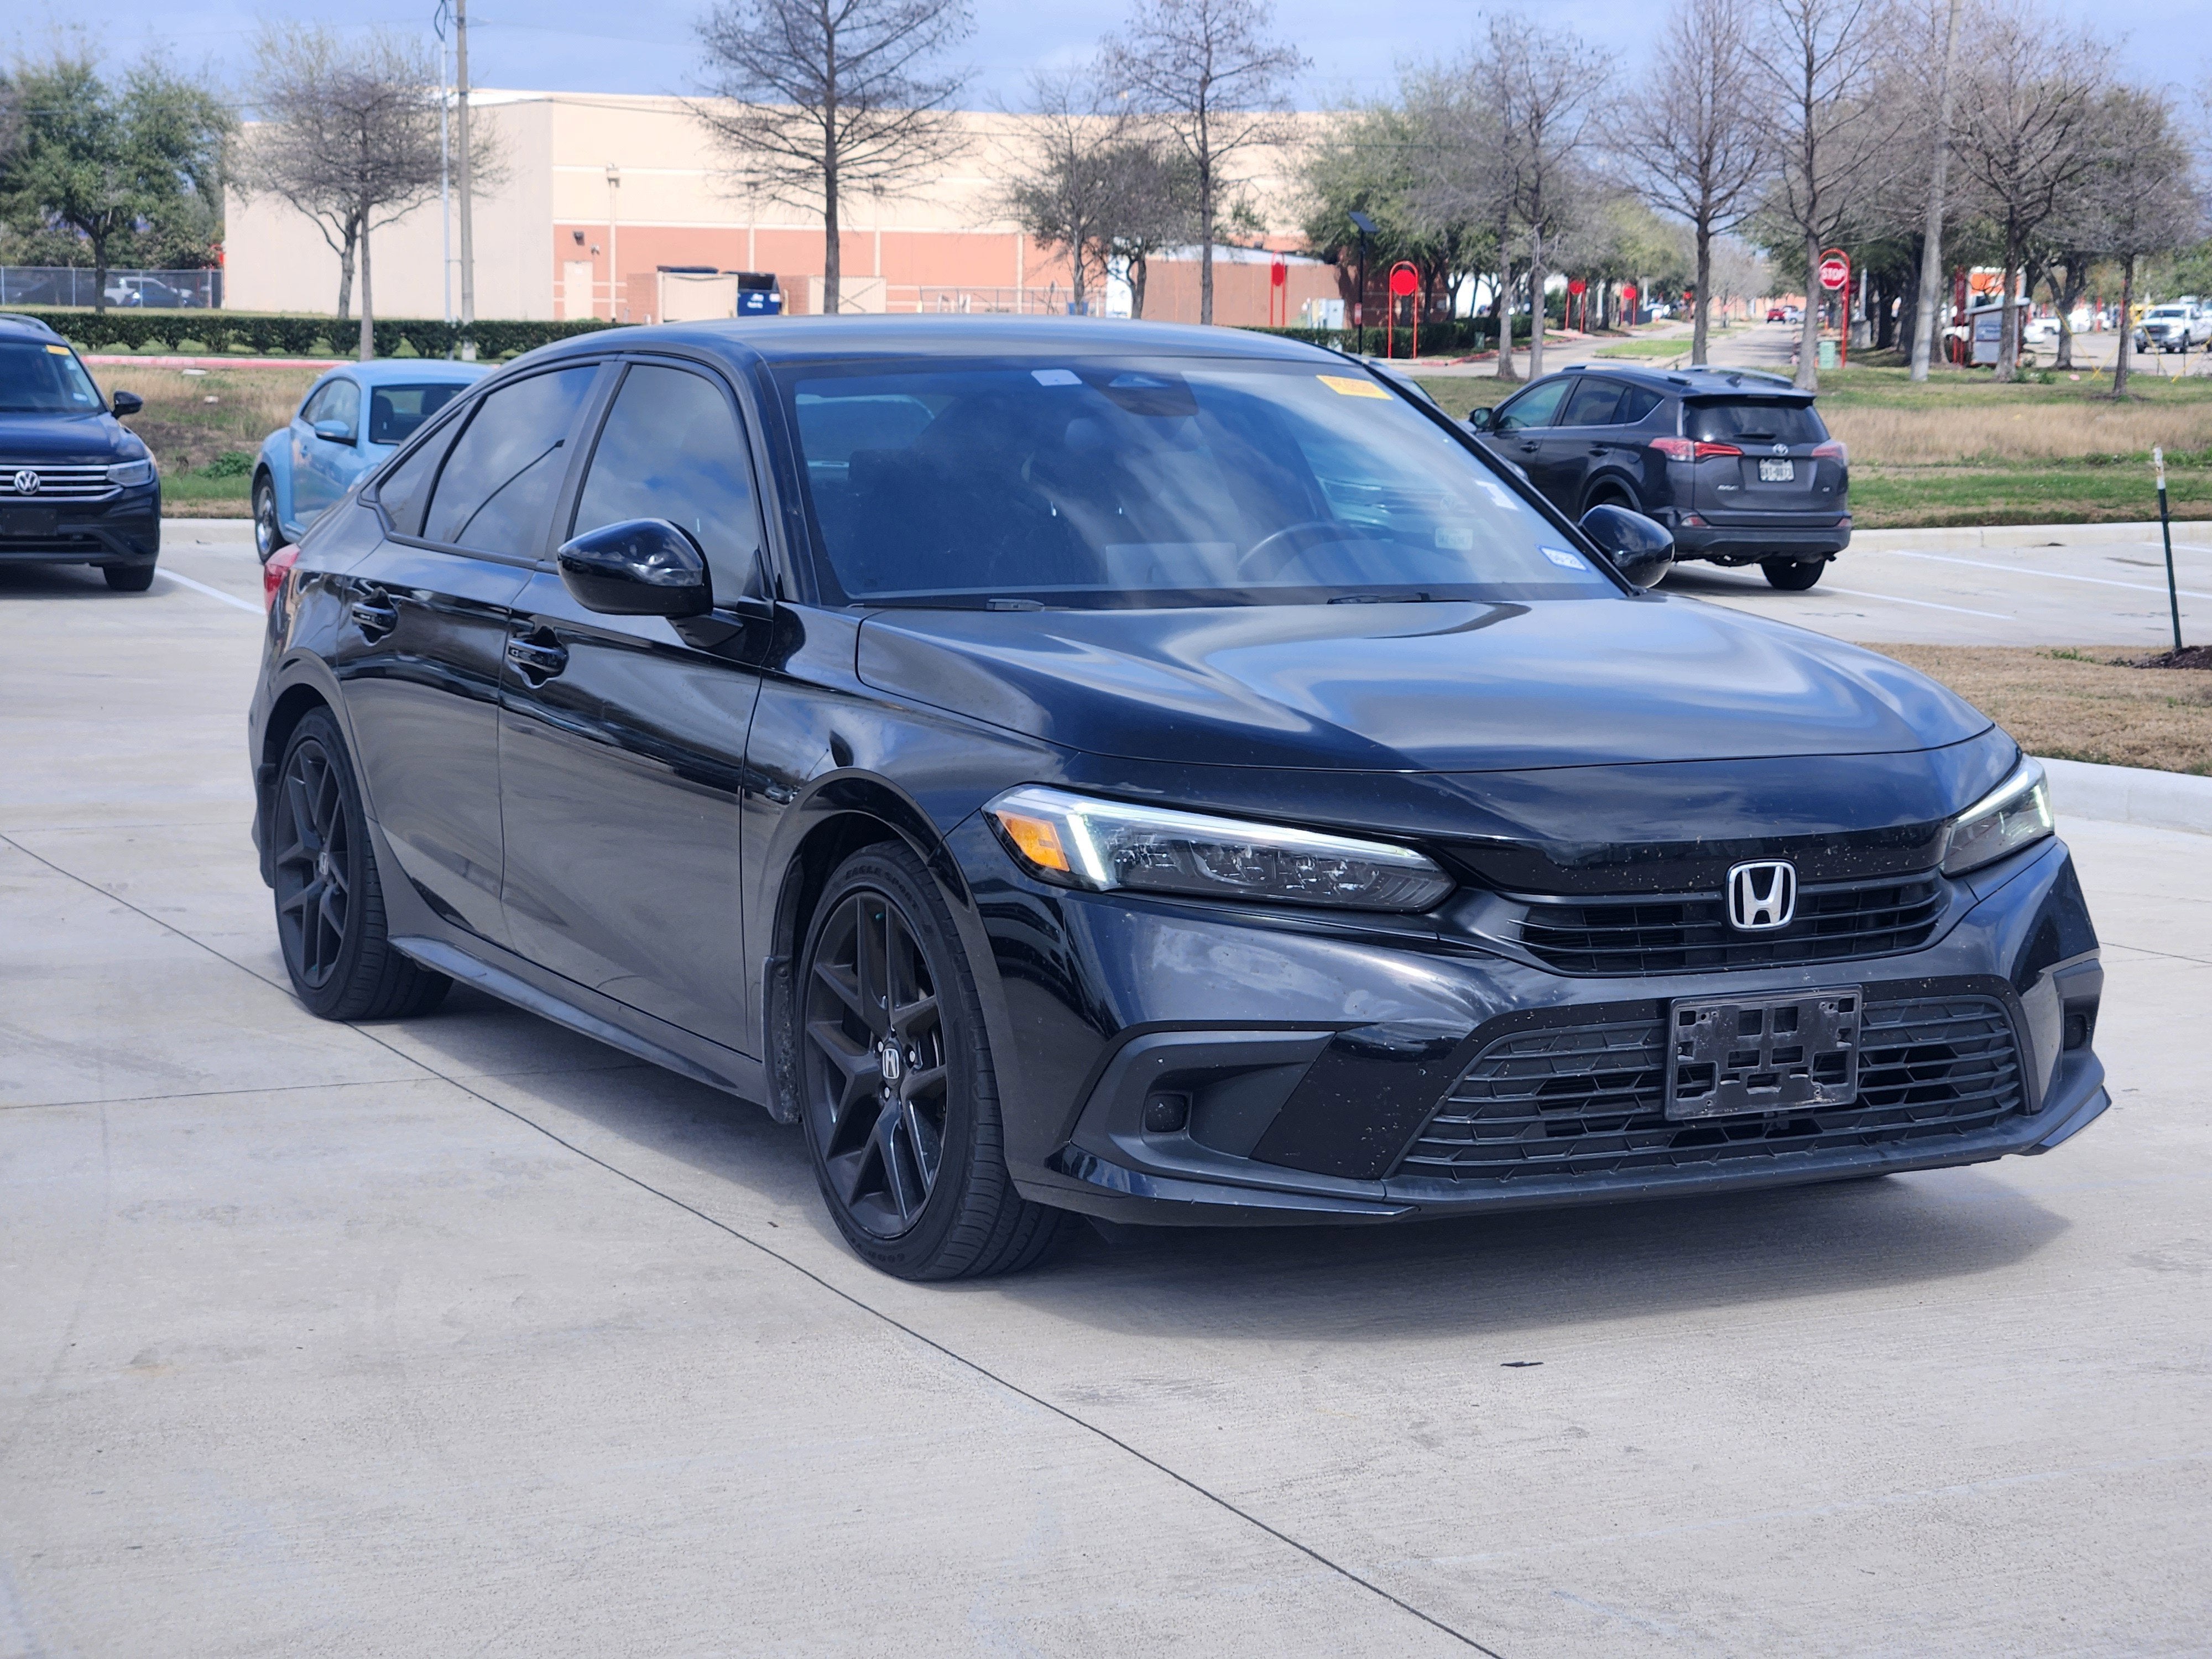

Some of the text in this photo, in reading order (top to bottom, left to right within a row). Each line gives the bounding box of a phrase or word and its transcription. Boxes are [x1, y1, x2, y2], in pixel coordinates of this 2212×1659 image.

[1821, 267, 1845, 280] STOP
[845, 865, 920, 911] EAGLE SPORT
